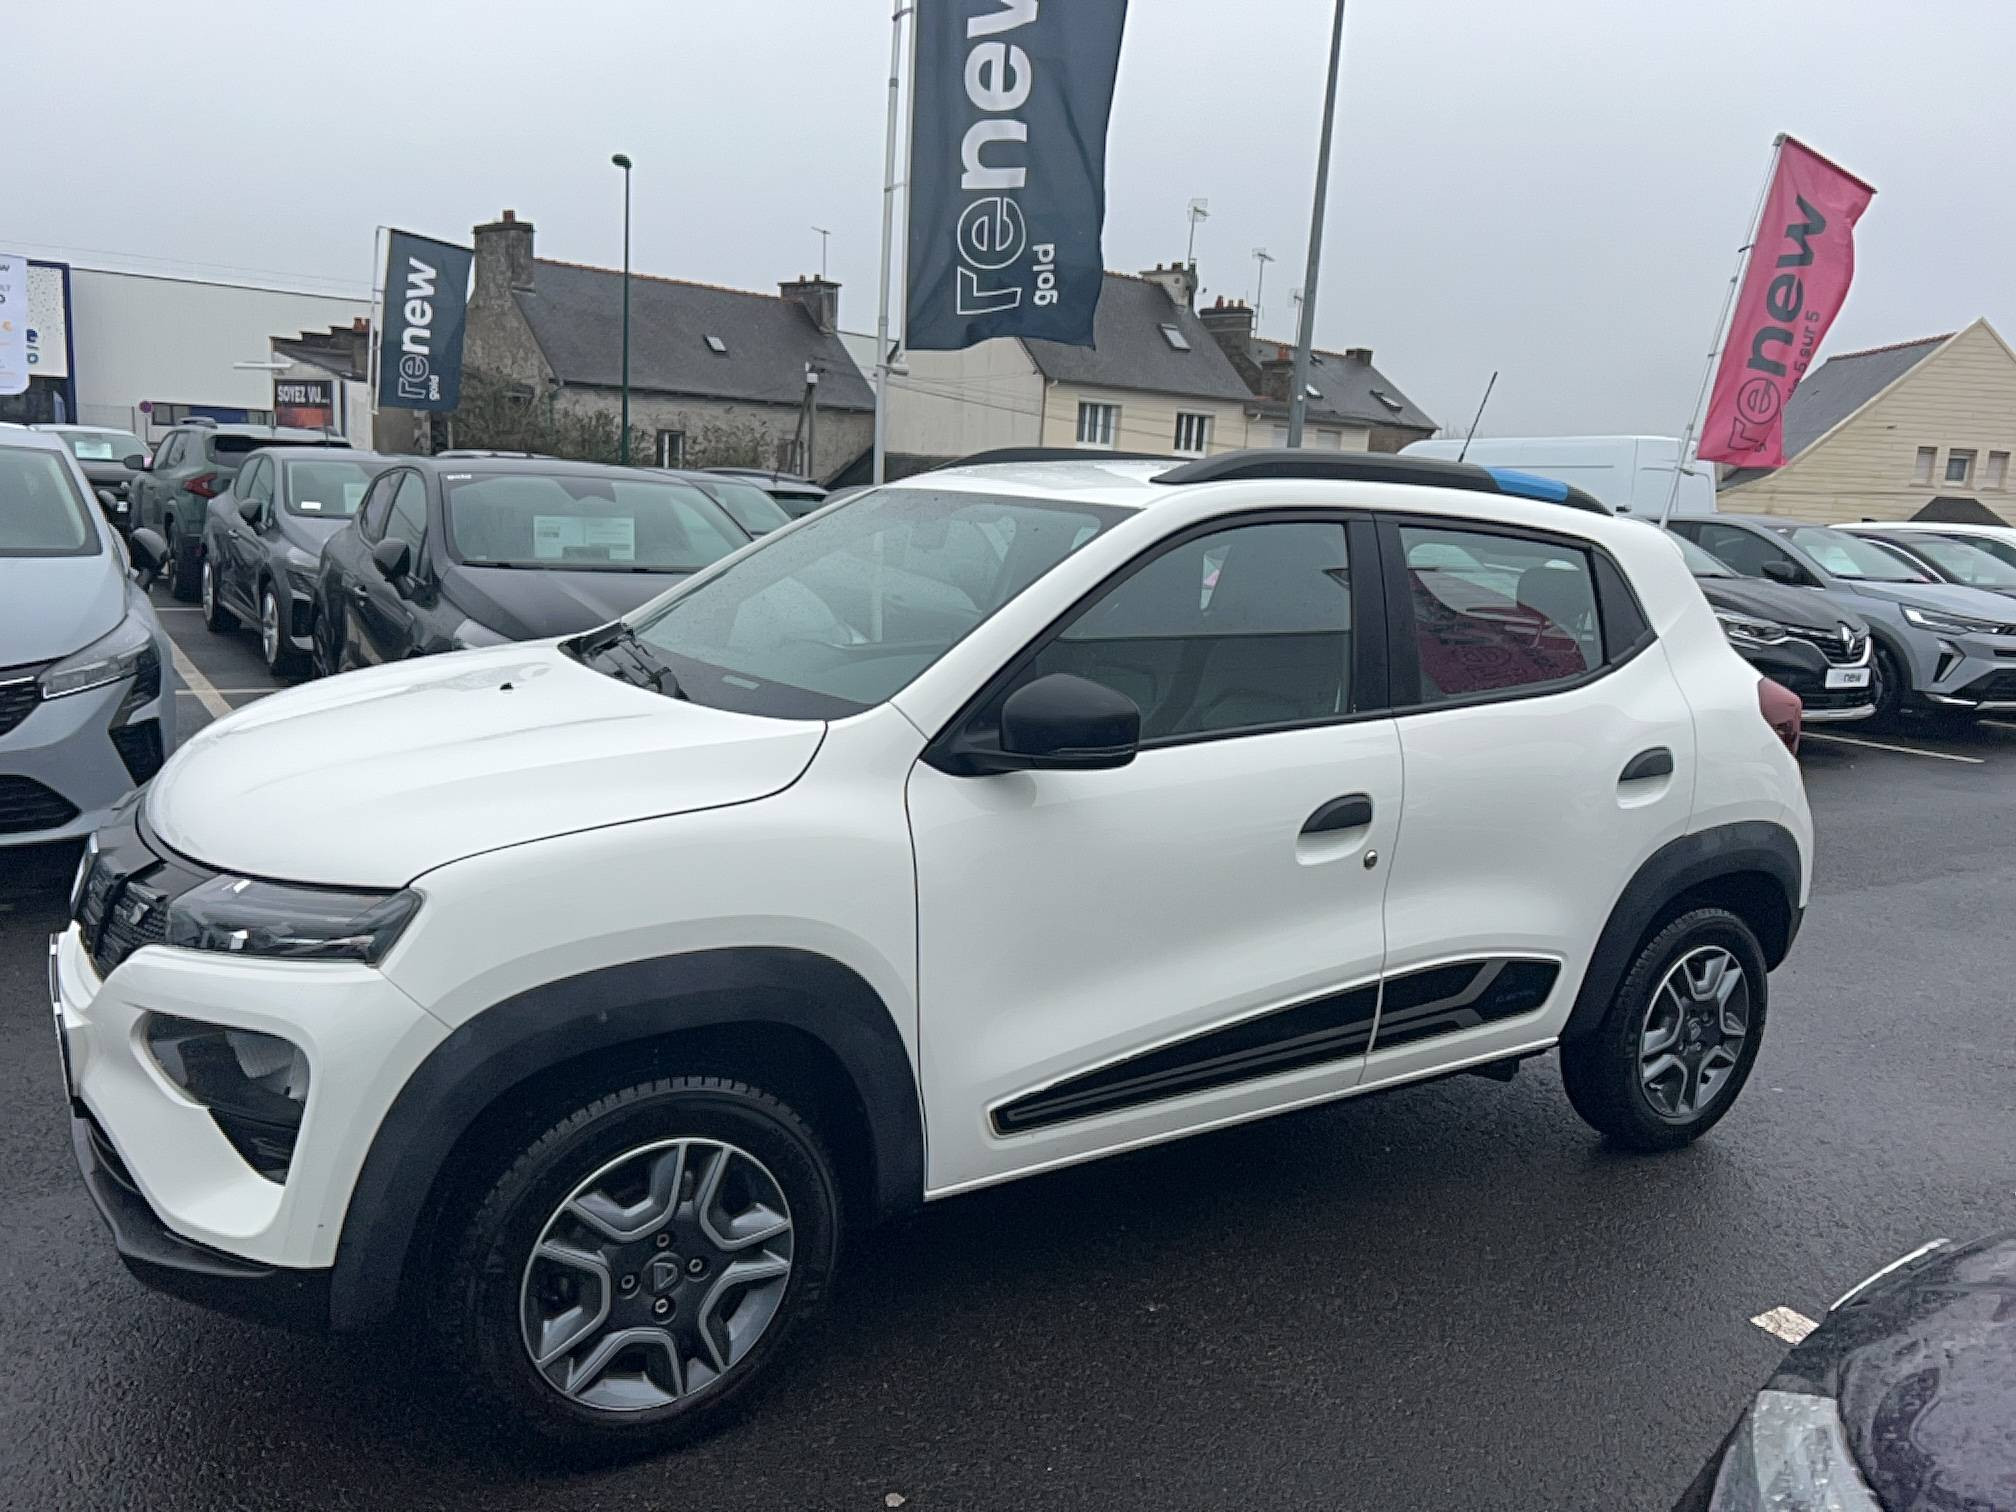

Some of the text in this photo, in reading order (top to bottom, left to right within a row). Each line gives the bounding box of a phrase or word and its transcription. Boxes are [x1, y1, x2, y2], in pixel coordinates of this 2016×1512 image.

[1033, 243, 1057, 306] gold
[398, 257, 437, 399] renew
[1728, 194, 1827, 448] renew
[1806, 310, 1820, 322] 5
[278, 385, 306, 403] SOYEZ
